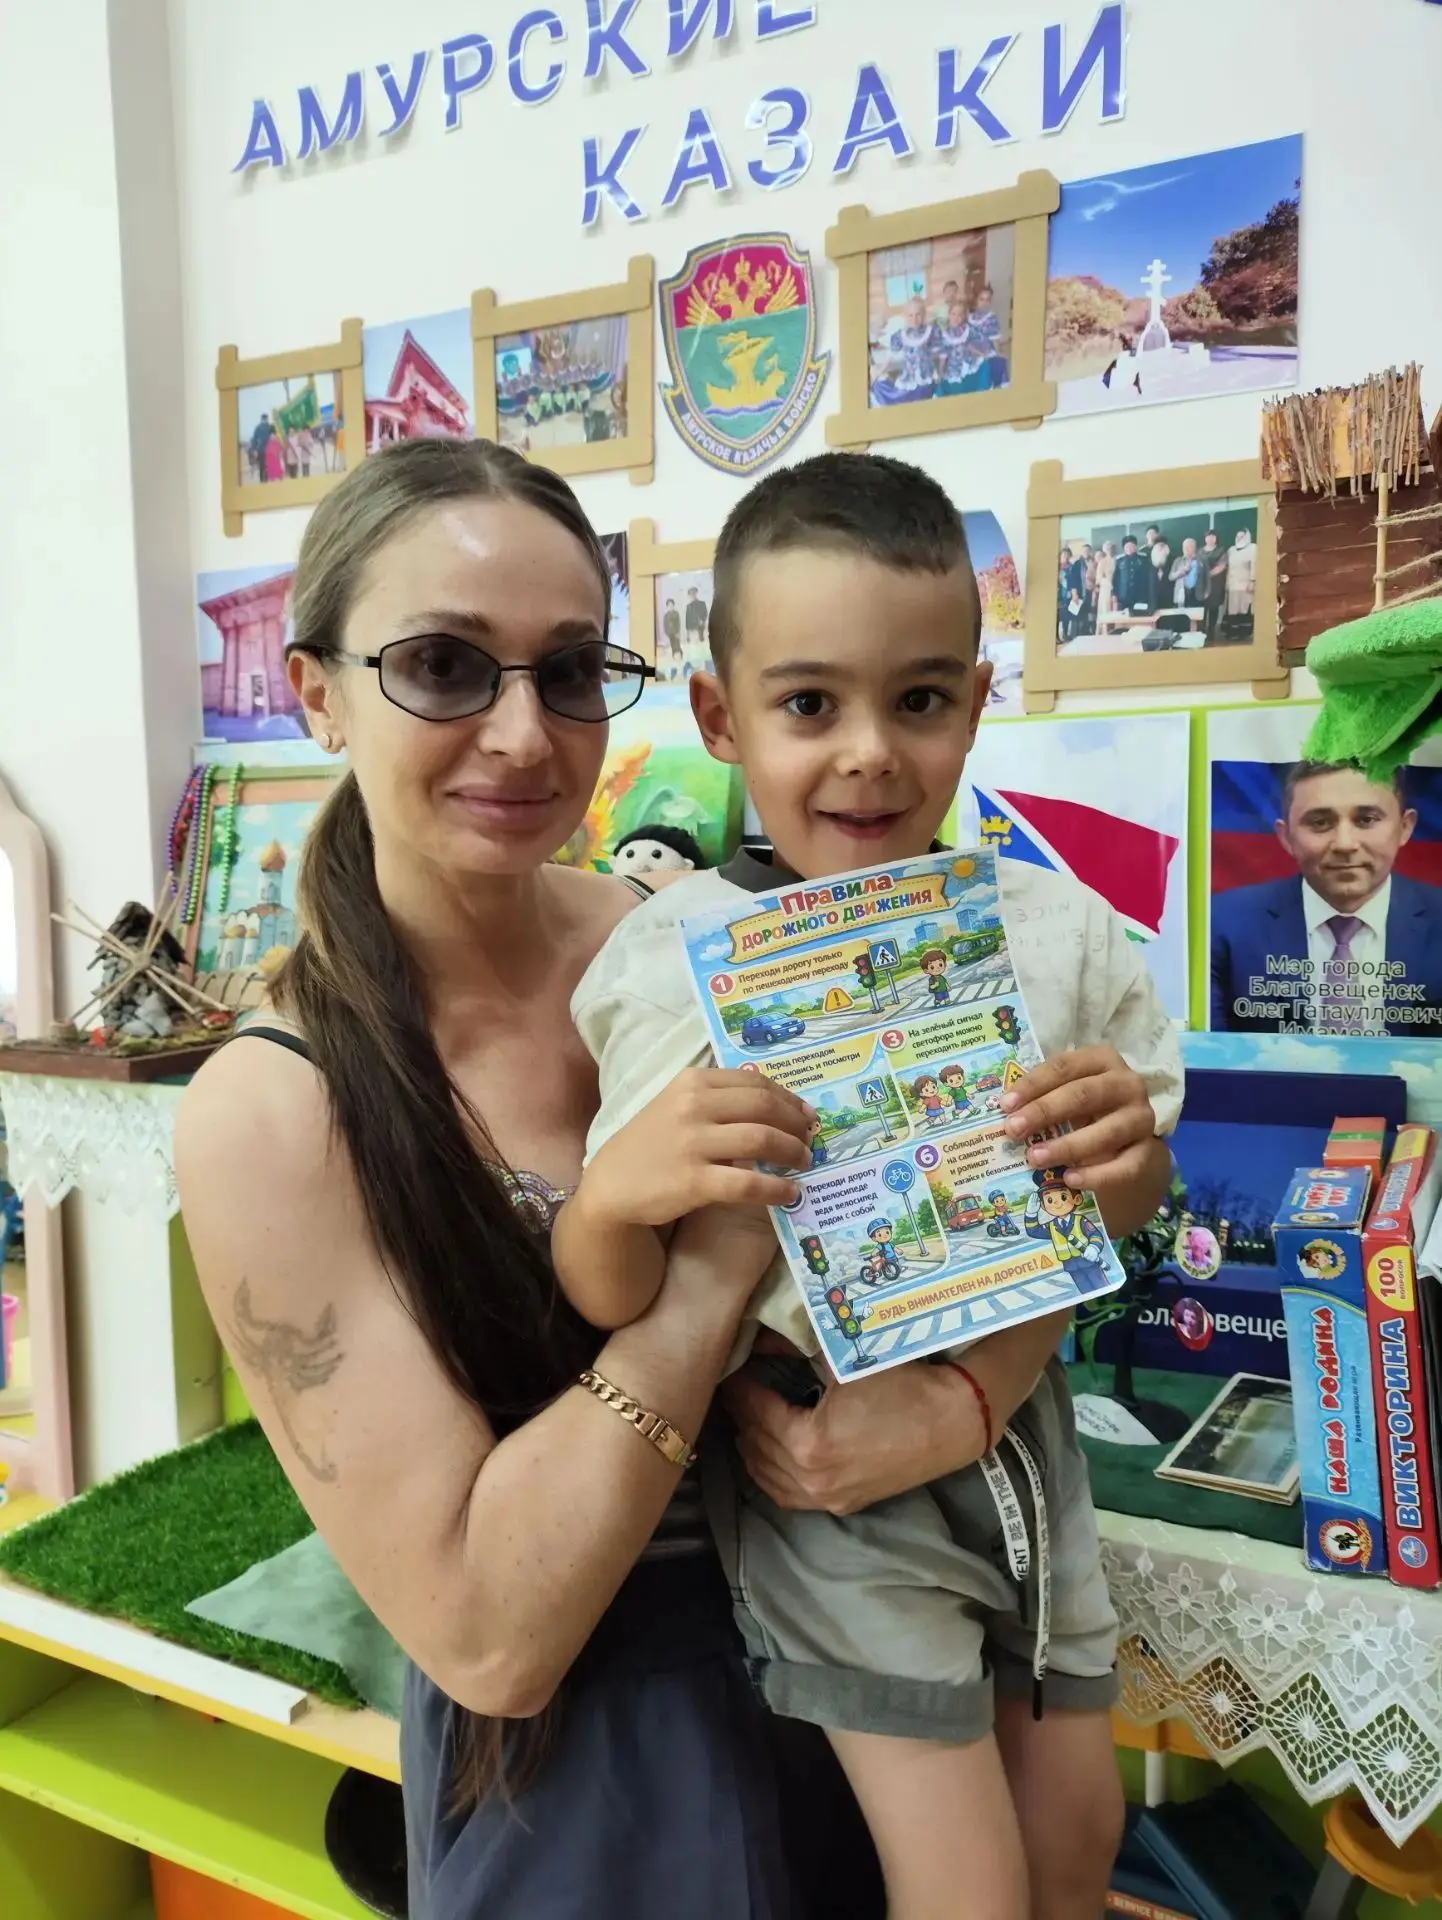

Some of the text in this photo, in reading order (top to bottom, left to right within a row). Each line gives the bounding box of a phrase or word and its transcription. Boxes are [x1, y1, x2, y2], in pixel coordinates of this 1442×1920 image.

[581, 1, 1128, 226] КАЗАКИ
[681, 412, 732, 461] АМУРСКОЕ
[783, 372, 817, 428] ВОЙСКО
[779, 874, 894, 916] Правила
[741, 888, 932, 951] ДОРОЖНОГО ДВИЖЕНИЯ
[738, 951, 843, 983] Переходи дорогу только
[743, 961, 849, 995] по пешеходному переходу
[1266, 954, 1407, 982] Мэр города
[716, 976, 727, 992] 1
[1248, 976, 1427, 1001] Благовещенск
[1233, 997, 1442, 1025] Олег Гатауллович
[908, 1012, 983, 1039] На зелёный сигнал
[912, 1024, 983, 1049] светофора можно
[886, 1032, 900, 1047] 3
[915, 1034, 986, 1060] переходить дорогу
[766, 1060, 791, 1071] Перед
[792, 1047, 836, 1065] переходом
[815, 1062, 821, 1070] и
[823, 1052, 861, 1068] посмотри
[785, 1073, 824, 1089] сторонам
[920, 1148, 934, 1165] 6
[943, 1134, 984, 1154] Соблюдай
[947, 1145, 994, 1165] на самокате
[949, 1168, 956, 1176] и
[957, 1158, 989, 1176] роликах
[806, 1168, 877, 1194] Переходи дорогу
[811, 1183, 868, 1206] на велосипеде
[815, 1192, 879, 1217] ведя велосипед
[818, 1203, 875, 1228] рядом с собой
[878, 1258, 1039, 1321] БУДЬ ВНИМАТЕЛЕН НА ДОРОГЕ!
[1378, 1257, 1397, 1298] 100
[1310, 1305, 1342, 1411] РОДИНА
[1380, 1317, 1423, 1529] ВИКТОРИНА
[1322, 1418, 1350, 1495] НАША
